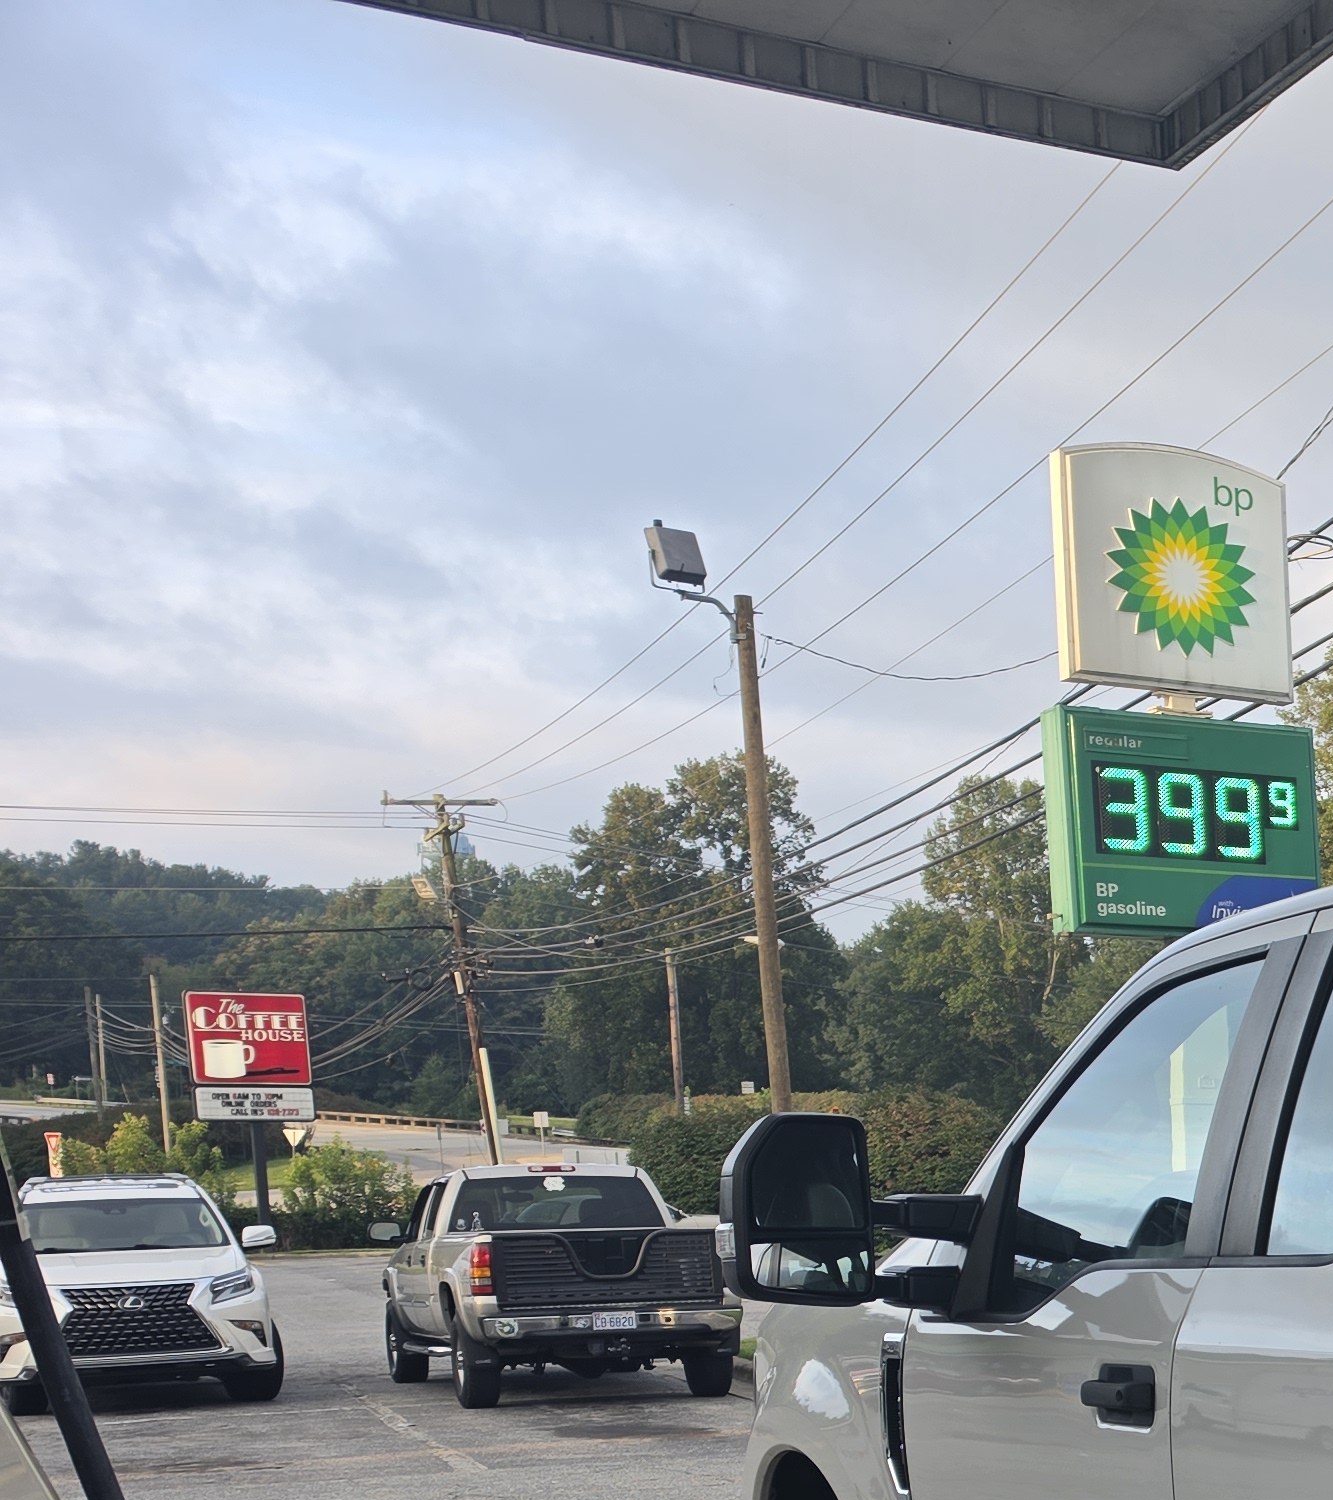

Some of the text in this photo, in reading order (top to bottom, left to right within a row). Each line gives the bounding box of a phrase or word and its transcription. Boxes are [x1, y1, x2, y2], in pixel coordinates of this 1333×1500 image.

[1213, 476, 1254, 517] bp
[1096, 882, 1119, 898] BP
[1097, 901, 1167, 917] gasoline
[219, 998, 245, 1014] The
[192, 1006, 305, 1030] COFFEE
[240, 1029, 305, 1042] HOUSE
[212, 1092, 230, 1100] OPEN
[251, 1092, 261, 1100] TO
[221, 1100, 277, 1108] ONLINE ORDERS
[231, 1108, 248, 1116] CALL
